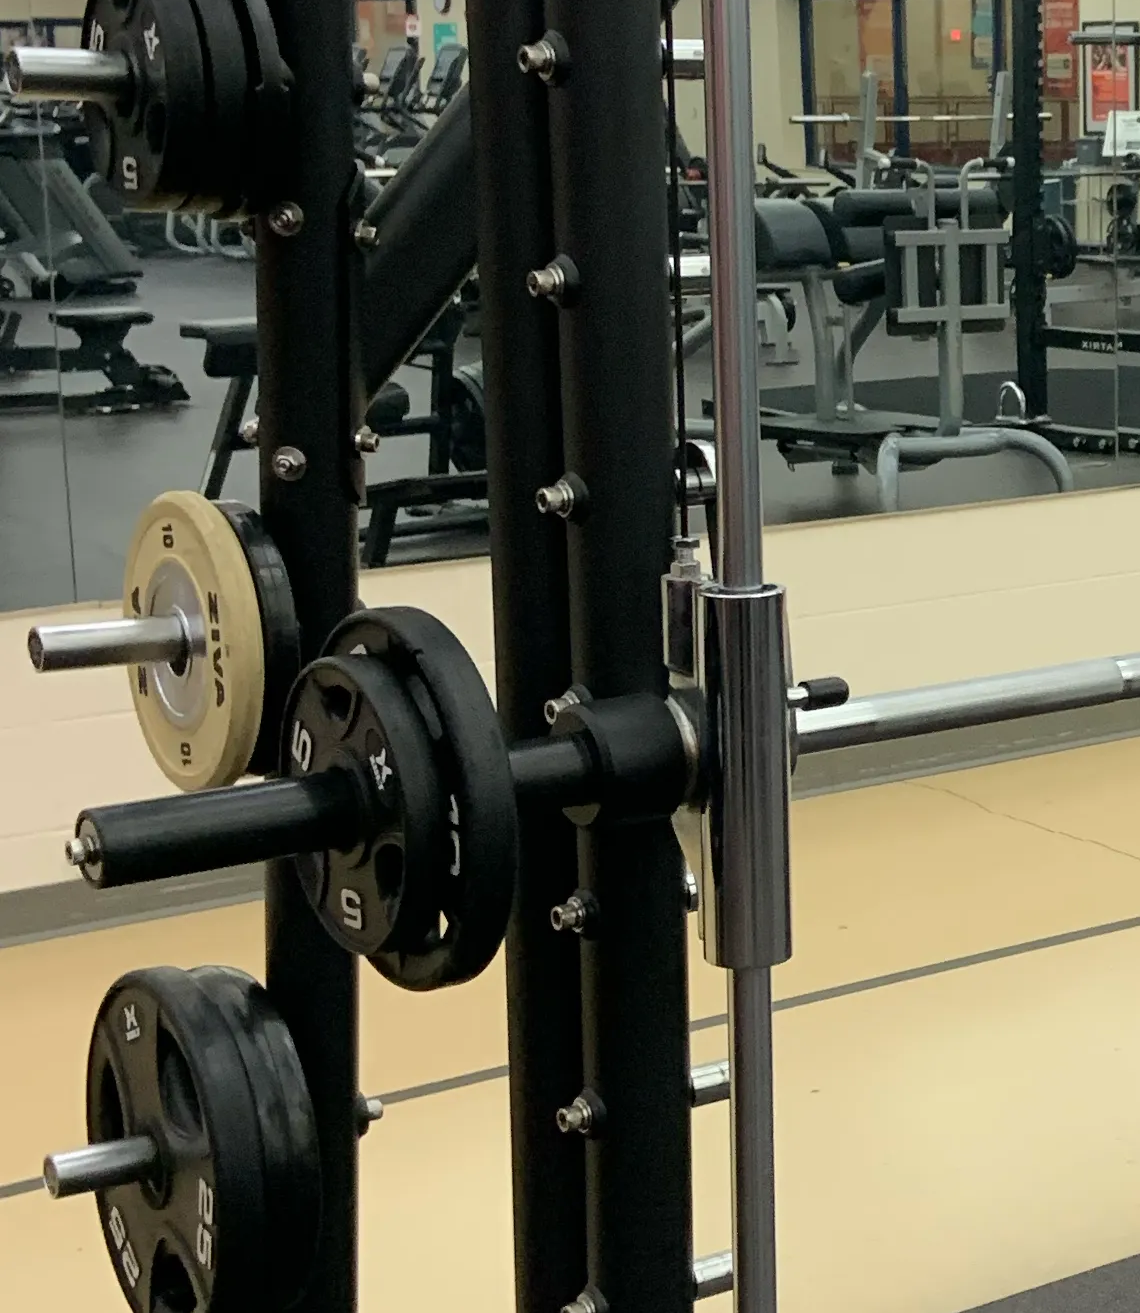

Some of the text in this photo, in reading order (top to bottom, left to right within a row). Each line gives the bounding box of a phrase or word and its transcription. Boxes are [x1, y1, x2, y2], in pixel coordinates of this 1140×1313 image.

[161, 523, 175, 549] 10
[207, 590, 226, 708] ZIVA
[180, 741, 192, 767] 10
[291, 720, 312, 772] 5
[340, 887, 363, 931] 5
[108, 1205, 141, 1289] 25
[197, 1177, 214, 1270] 25
